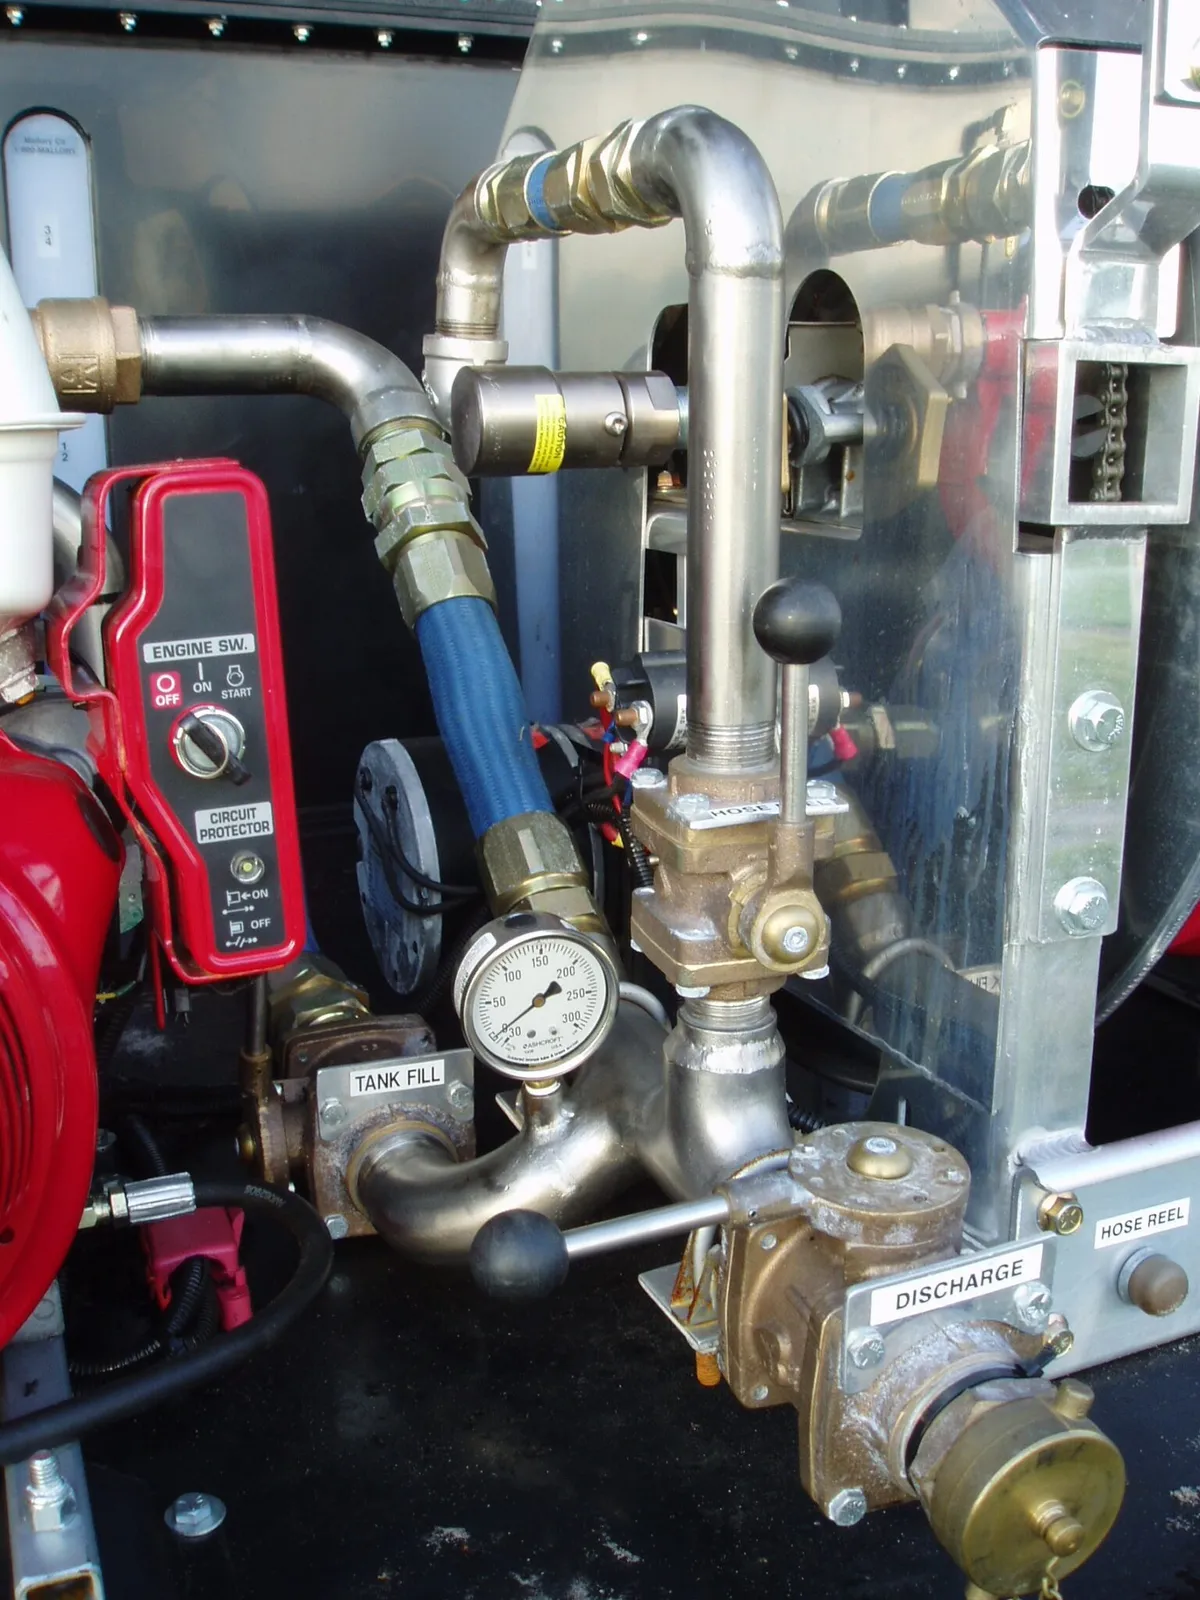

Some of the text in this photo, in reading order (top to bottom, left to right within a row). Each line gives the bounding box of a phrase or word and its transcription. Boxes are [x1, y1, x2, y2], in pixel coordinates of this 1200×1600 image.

[553, 417, 566, 459] CAUTION
[153, 638, 248, 659] ENGINE SW.
[193, 681, 212, 693] ON
[221, 687, 252, 699] START
[155, 694, 180, 706] OFF
[210, 808, 257, 825] CIRCUIT
[711, 805, 768, 816] HOSE
[200, 821, 270, 840] PROTECTOR
[252, 889, 269, 899] ON
[250, 918, 271, 929] OFF
[532, 955, 549, 968] 150
[504, 970, 522, 983] 100
[556, 966, 576, 979] 200
[567, 988, 585, 1001] 250
[493, 996, 506, 1008] 50
[562, 1011, 581, 1024] 300
[509, 1026, 521, 1037] 30
[355, 1066, 440, 1092] TANK FILL
[1101, 1207, 1184, 1240] HOSE REEL
[896, 1259, 1023, 1310] DISCHARGE
